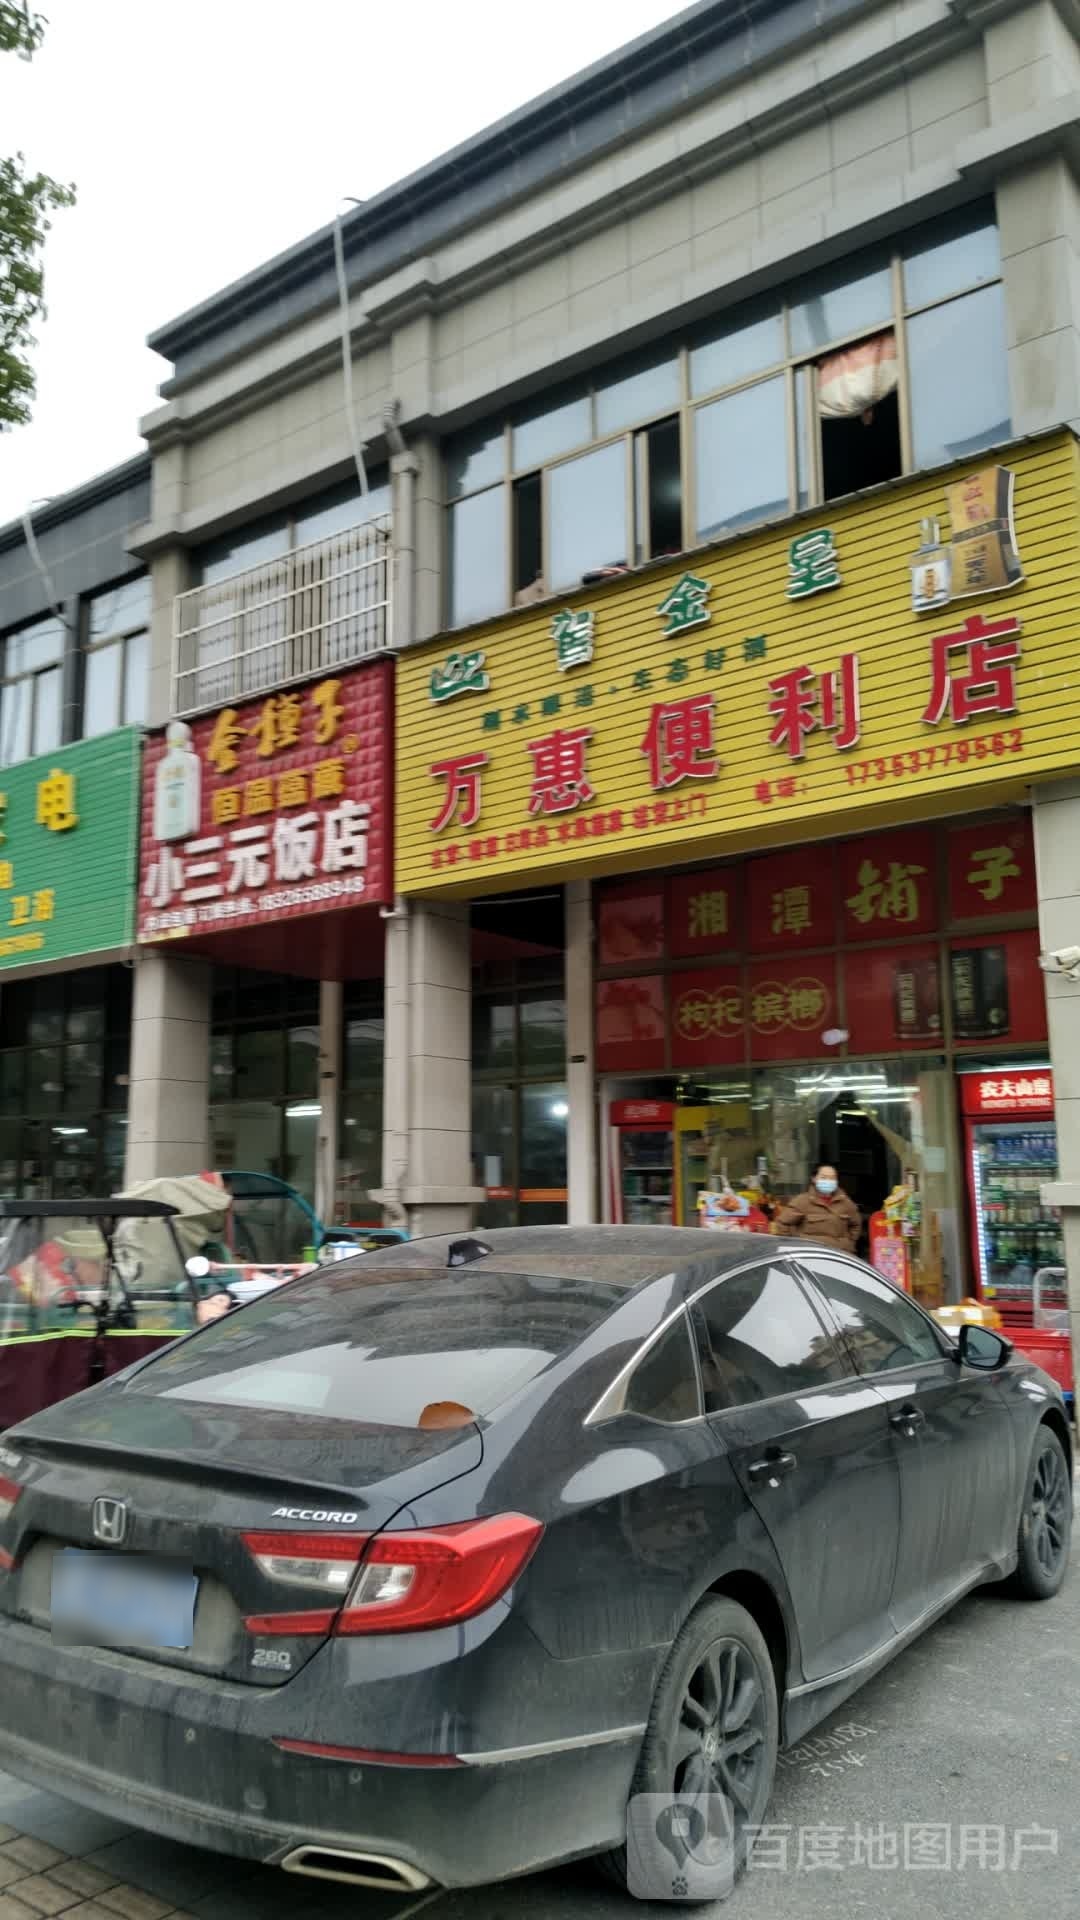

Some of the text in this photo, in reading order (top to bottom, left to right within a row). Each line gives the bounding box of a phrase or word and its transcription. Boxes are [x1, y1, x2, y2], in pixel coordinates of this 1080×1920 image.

[428, 614, 1020, 833] 万惠便利店
[143, 799, 371, 908] 小三元饭店
[687, 845, 1021, 938] 湘潭铺子
[271, 1507, 358, 1524] ACCORD
